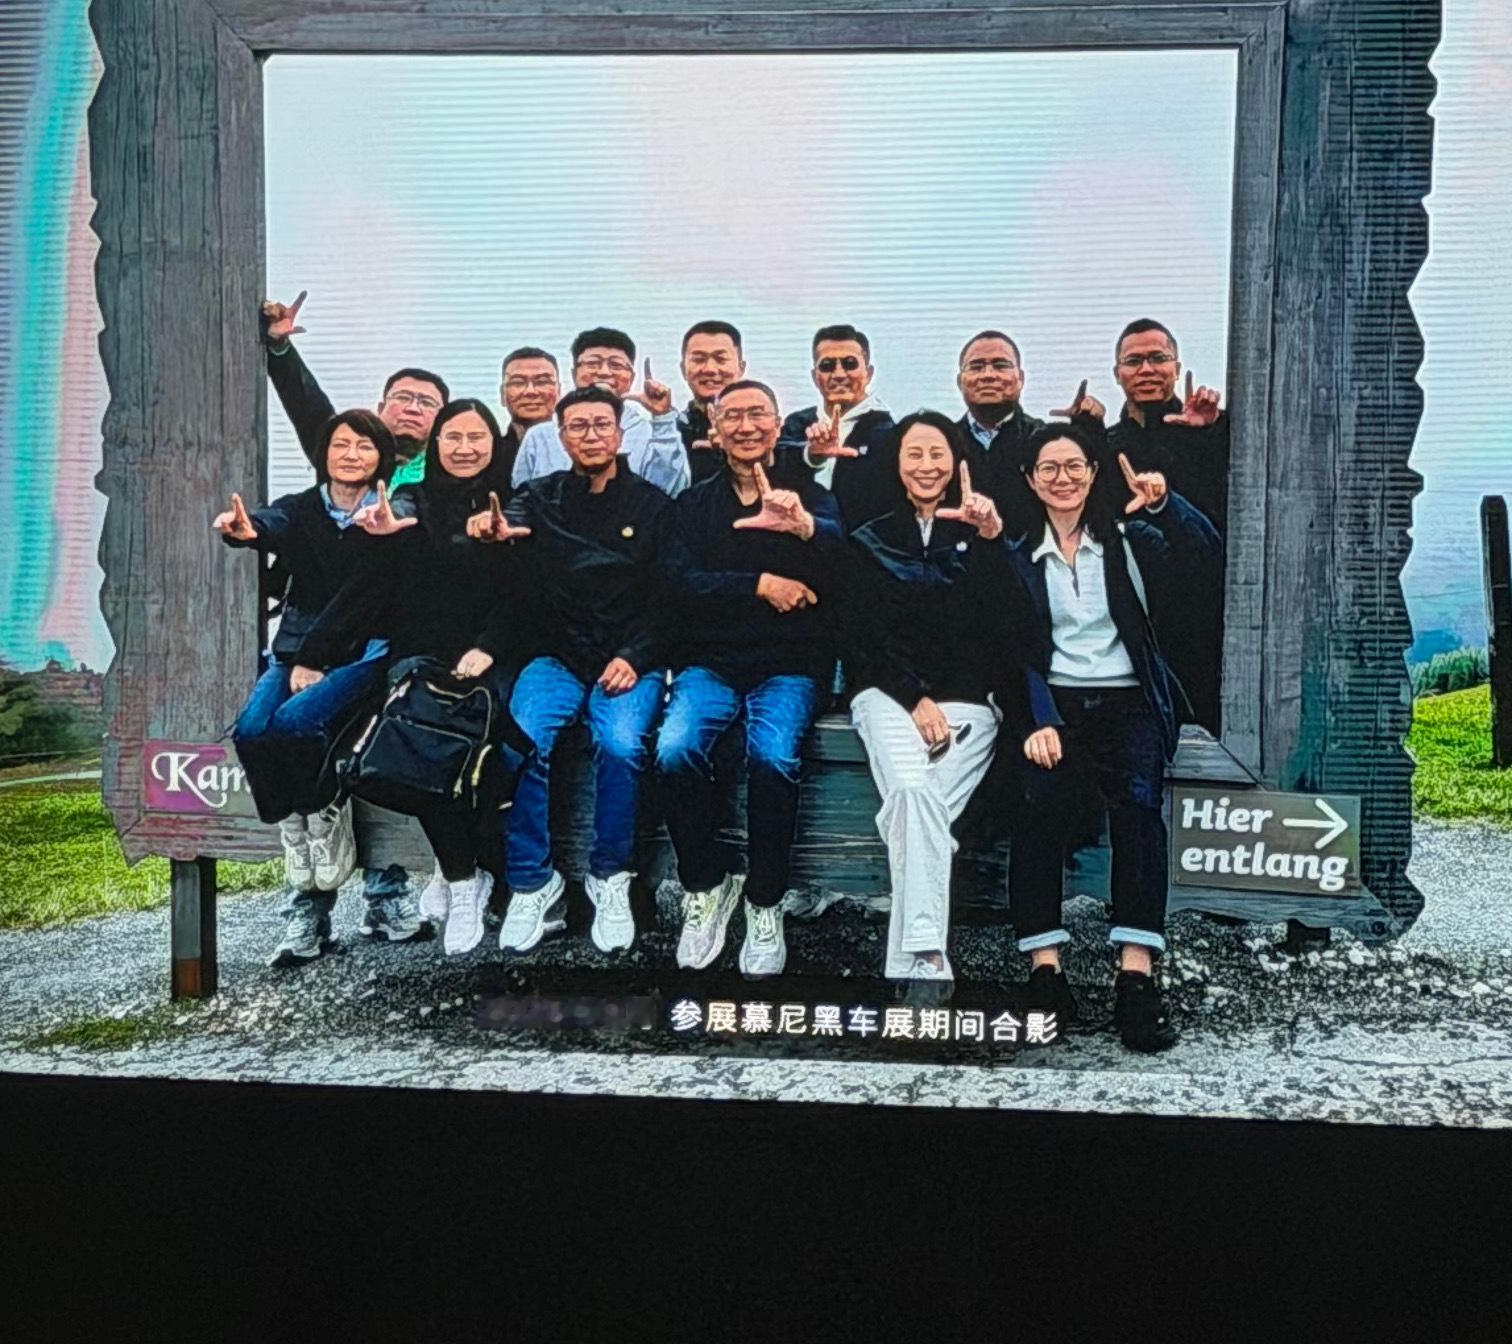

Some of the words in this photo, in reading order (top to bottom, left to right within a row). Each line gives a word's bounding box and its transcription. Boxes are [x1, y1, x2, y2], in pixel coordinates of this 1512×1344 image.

[1181, 797, 1273, 833] Hier
[1180, 842, 1349, 892] entlang
[670, 998, 1058, 1044] 参展慕尼黑车展期间合影
